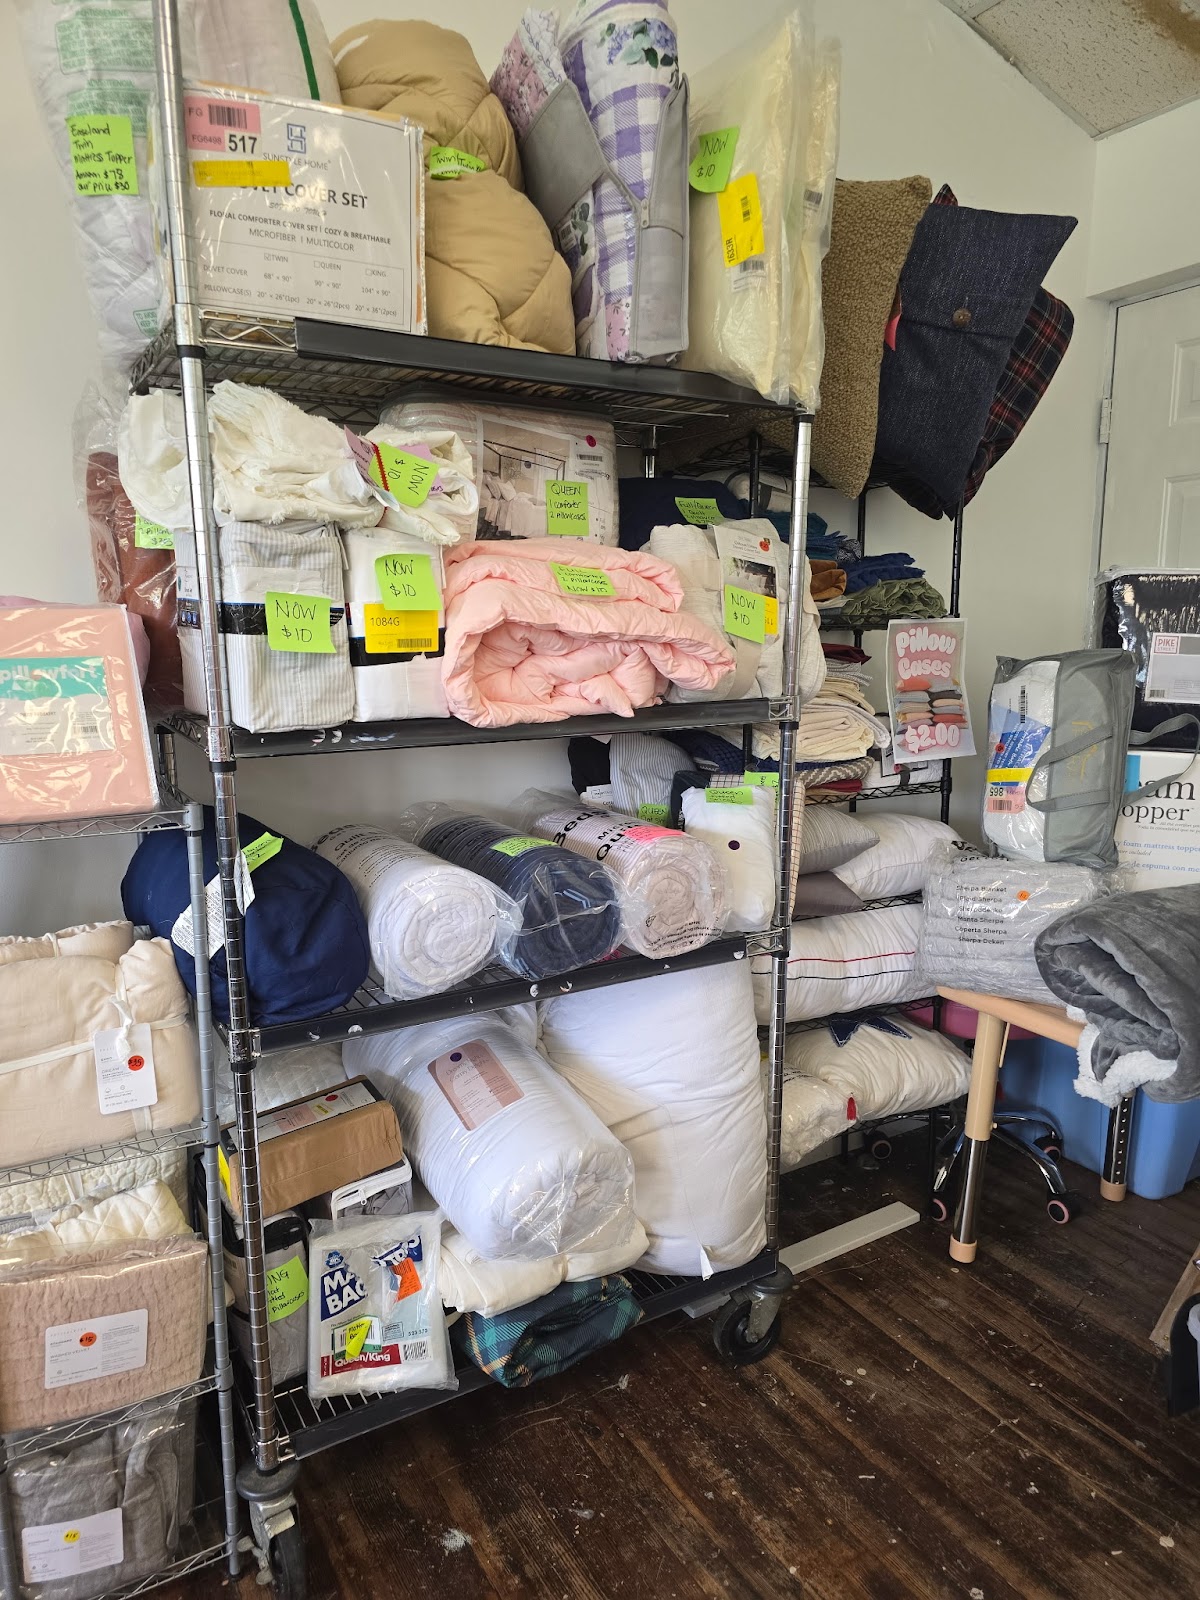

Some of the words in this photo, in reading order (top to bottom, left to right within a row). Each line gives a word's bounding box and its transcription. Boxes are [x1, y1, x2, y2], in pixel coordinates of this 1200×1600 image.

[188, 107, 203, 117] FG
[228, 133, 258, 154] 517
[702, 133, 729, 158] NOW
[696, 163, 716, 178] $10
[285, 183, 337, 205] COVER
[341, 191, 368, 210] SET
[209, 209, 236, 221] FLORAL
[237, 214, 281, 227] COMFORTER
[282, 220, 305, 231] COVER
[306, 224, 319, 233] SET
[324, 227, 342, 236] COZY
[350, 231, 391, 245] BREATHABLE
[249, 228, 297, 243] MICROFIBER
[306, 236, 354, 252] MULTICOLOR
[226, 266, 248, 276] COVER
[408, 462, 430, 497] NOW
[551, 482, 582, 496] QUEEN
[384, 559, 414, 577] NOW
[389, 583, 417, 598] $10
[730, 592, 756, 610] NOW
[275, 599, 317, 621] NOW
[370, 616, 400, 627] 1084G
[733, 611, 751, 626] $10
[281, 625, 313, 643] $10
[895, 626, 956, 658] Pillow
[1157, 638, 1176, 647] PIKE
[898, 657, 951, 680] Cases
[905, 722, 960, 754] $2.00
[989, 786, 1005, 798] 865
[1119, 803, 1190, 824] opper
[1123, 840, 1142, 848] foam
[1143, 842, 1175, 851] mattress
[1128, 849, 1153, 857] included
[1131, 860, 1141, 868] de
[1141, 862, 1170, 872] espuma
[1171, 864, 1186, 872] con
[979, 917, 1004, 925] Sherpa
[954, 925, 982, 934] Coperta
[983, 927, 1008, 935] Sherpa
[958, 935, 981, 944] Sherpa
[266, 1269, 290, 1285] ING
